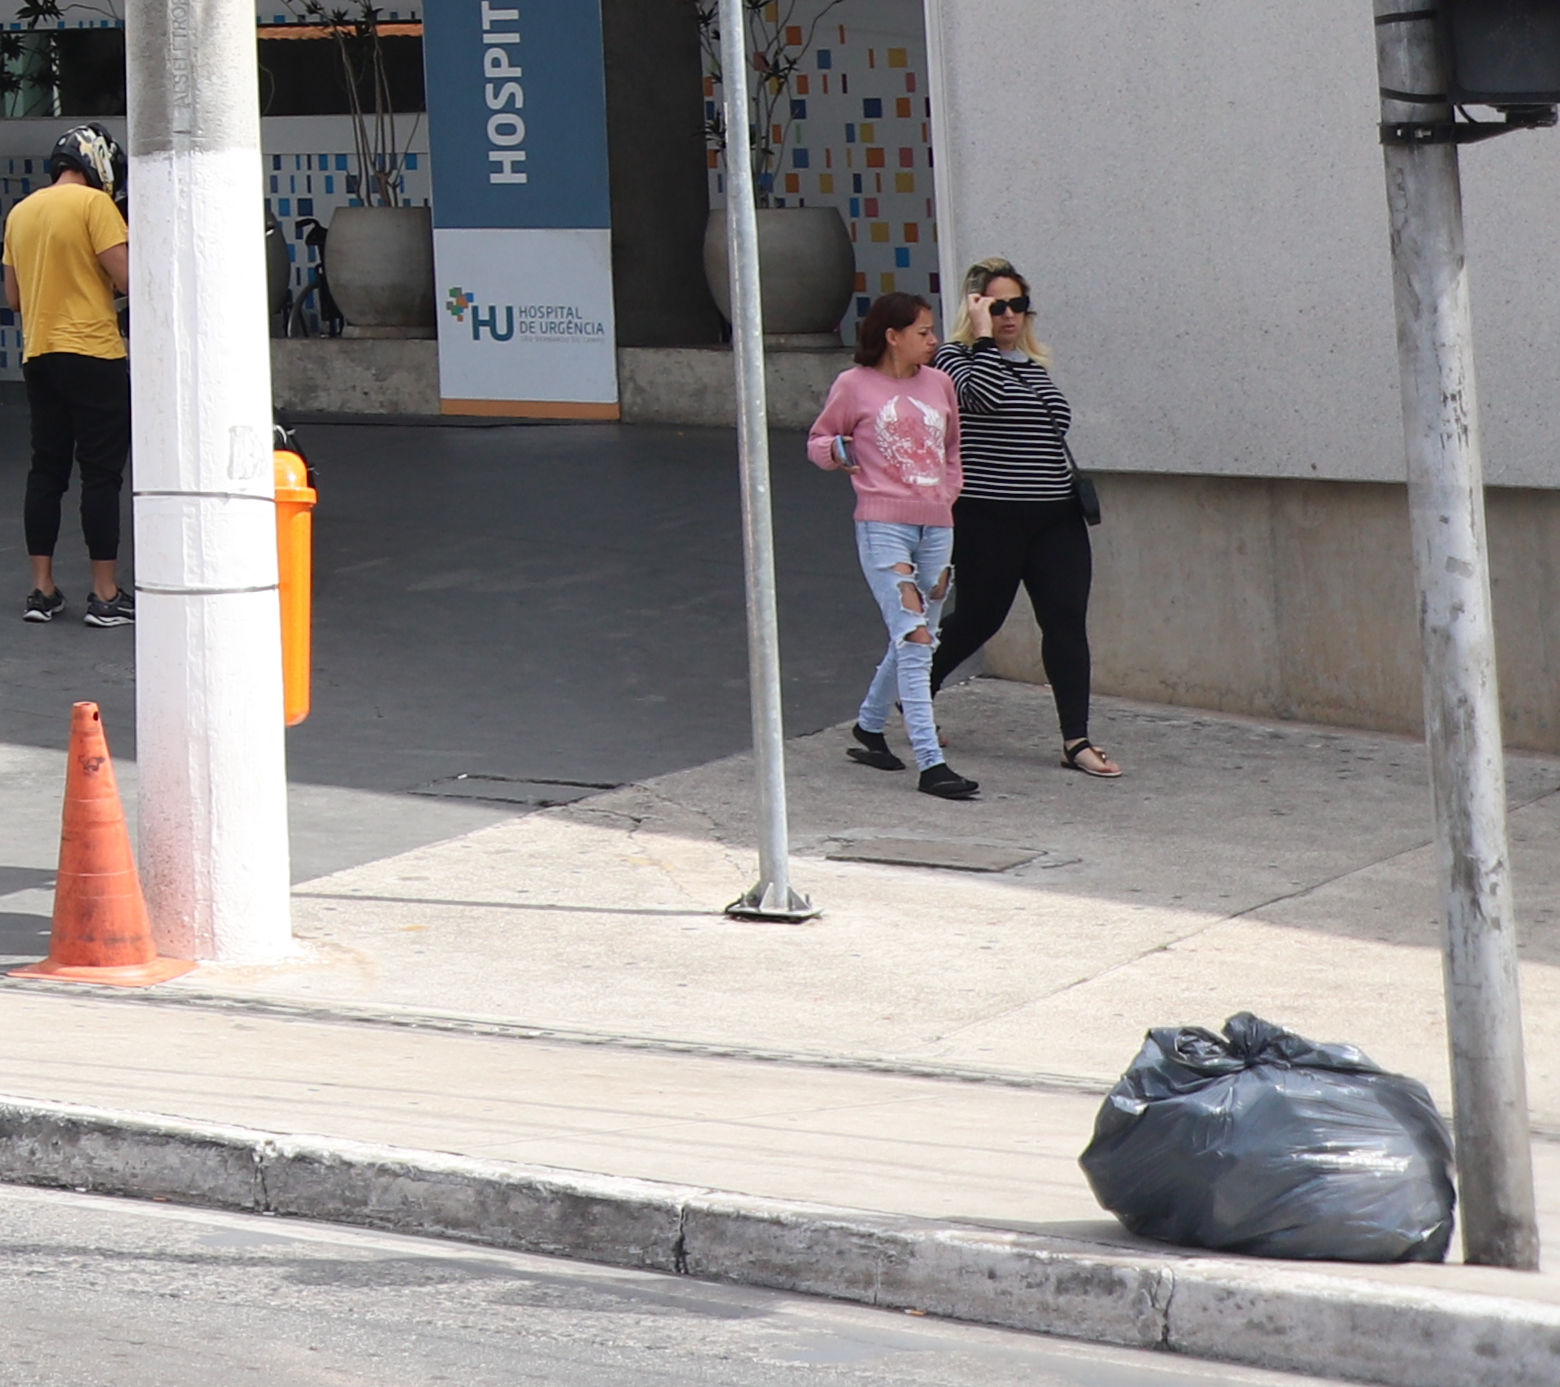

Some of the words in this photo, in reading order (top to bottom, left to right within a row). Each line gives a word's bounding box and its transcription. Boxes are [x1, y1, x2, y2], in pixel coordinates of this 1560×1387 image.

[518, 305, 582, 319] HOSPITAL
[472, 305, 514, 341] HU
[519, 321, 536, 334] DE
[540, 319, 605, 335] URGÊNCIA
